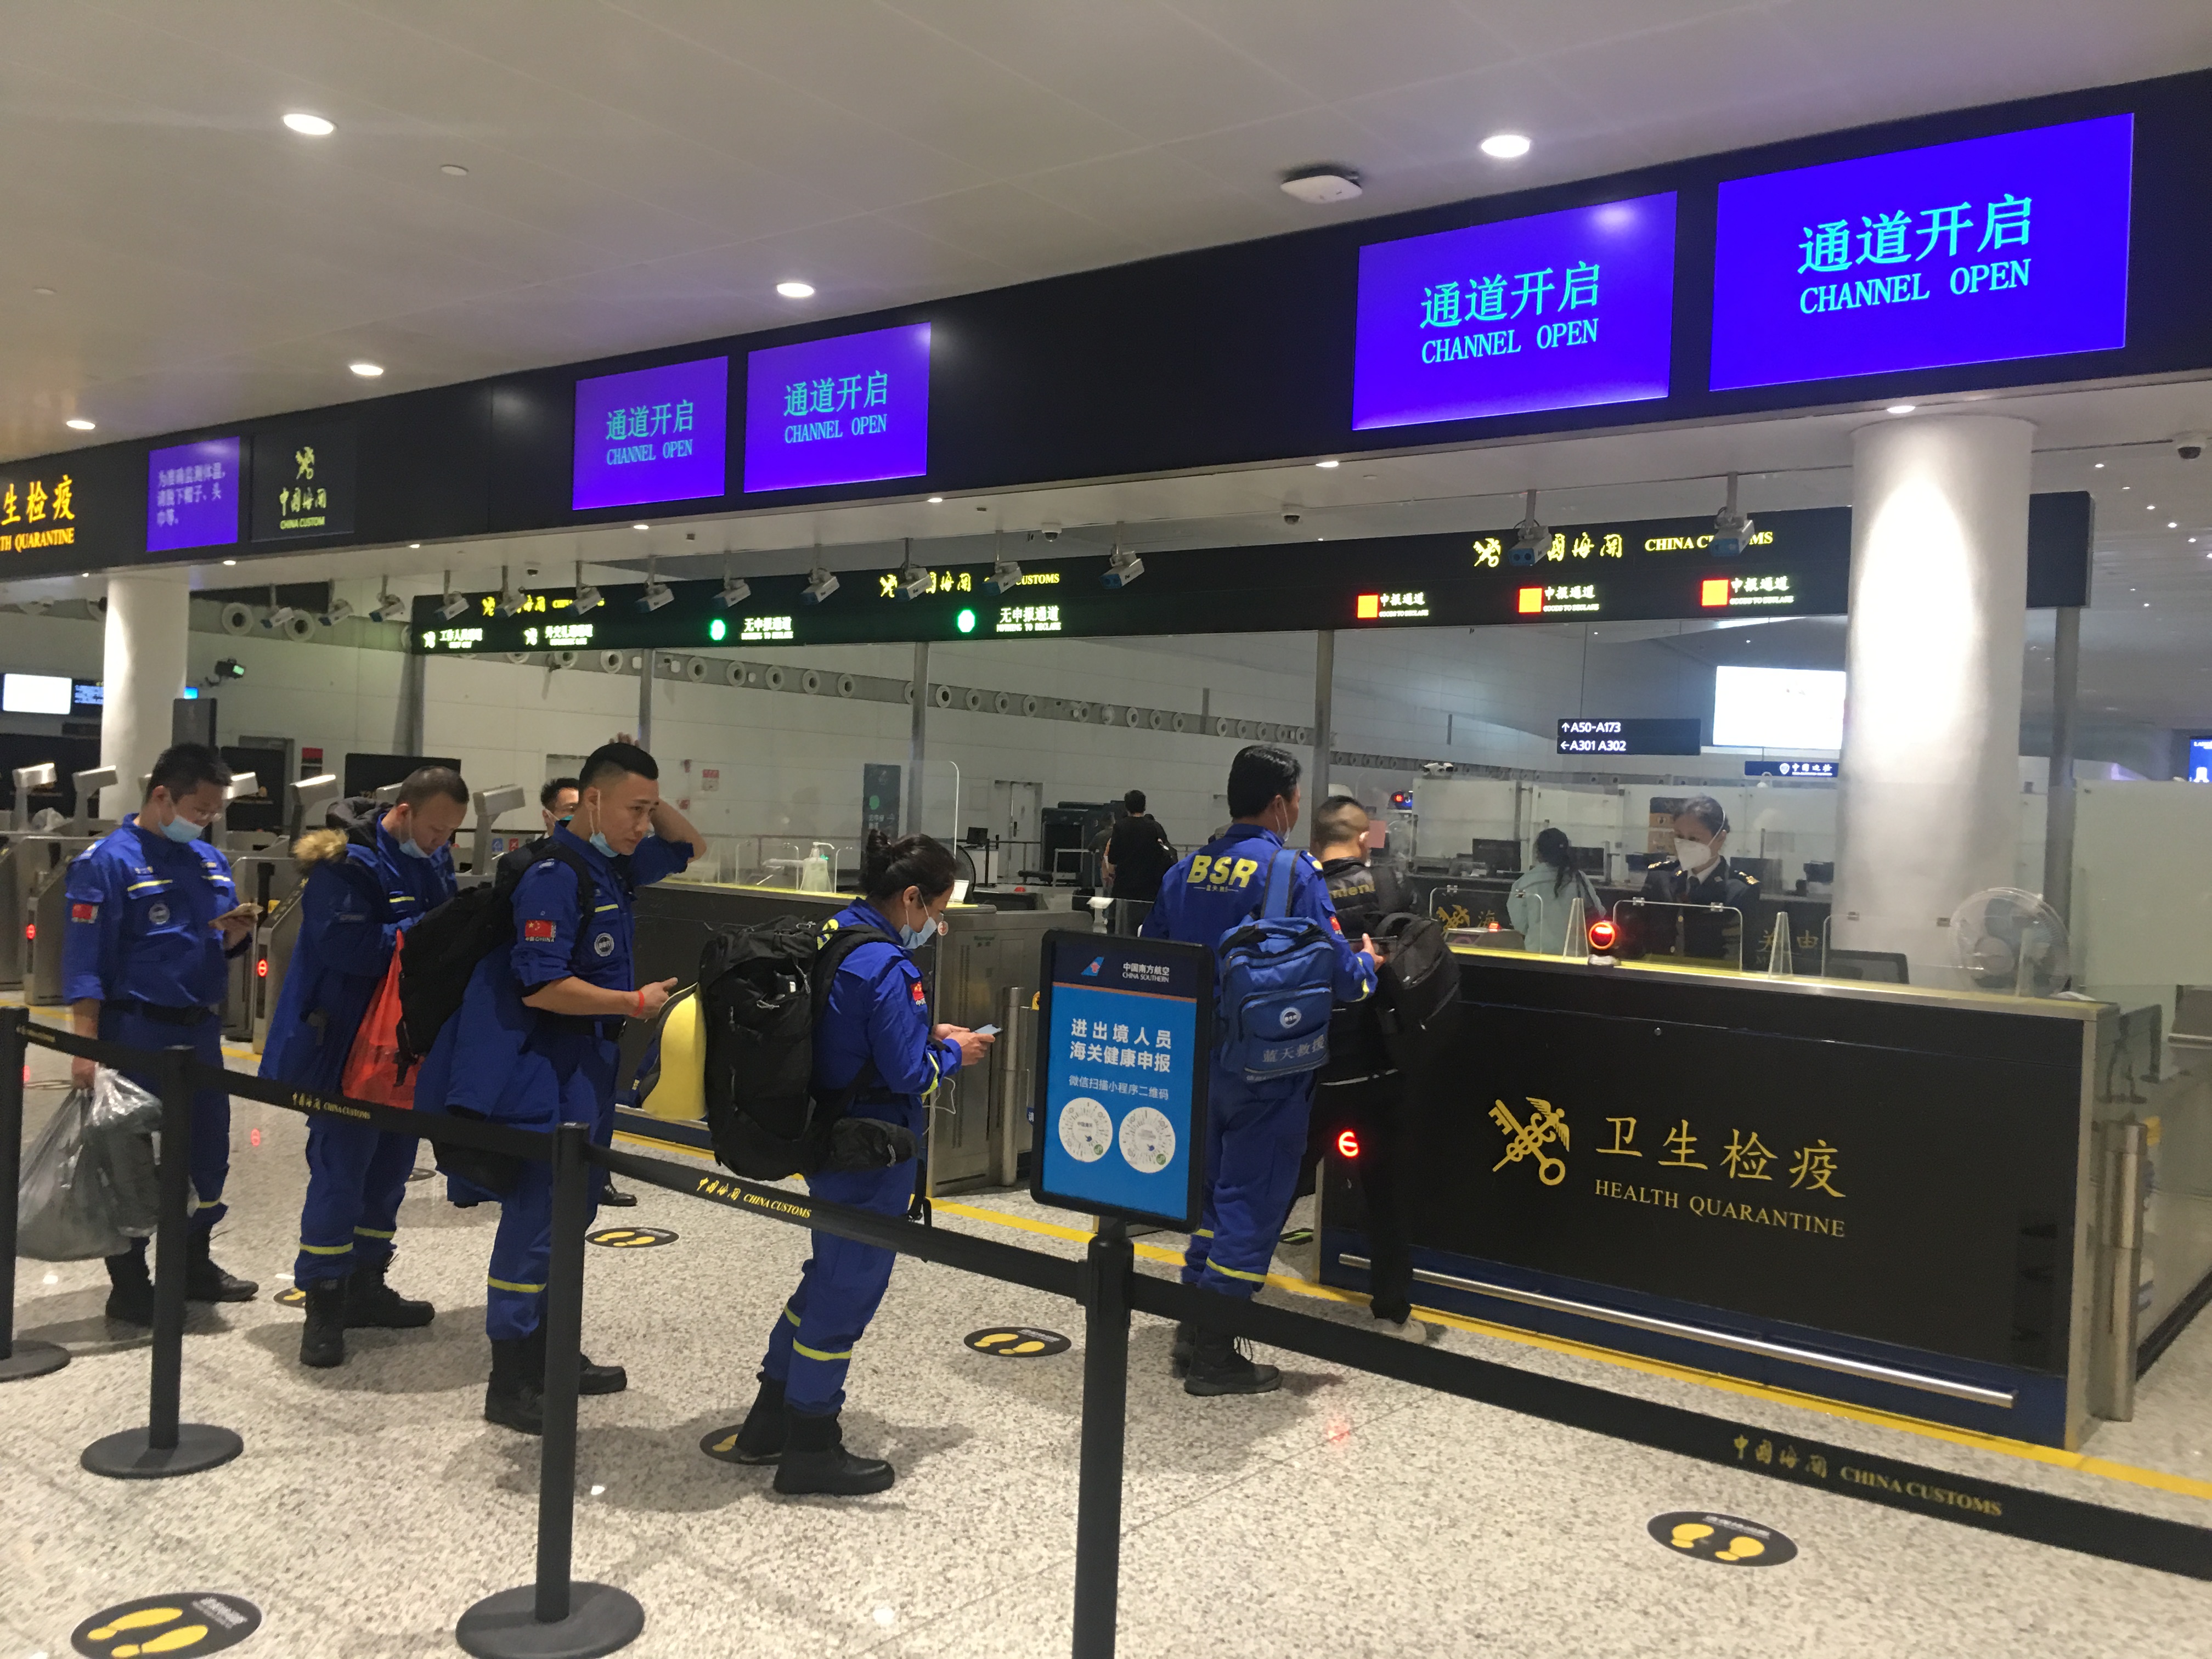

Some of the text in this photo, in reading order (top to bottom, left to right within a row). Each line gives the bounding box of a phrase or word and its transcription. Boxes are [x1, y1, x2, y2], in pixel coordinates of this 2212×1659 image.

[1798, 194, 2032, 274] 通道开启
[1420, 261, 1600, 329] 通道开启
[1800, 259, 2032, 314] CHANNEL OPEN
[1422, 318, 1599, 363] CHANNEL OPEN
[784, 370, 888, 416] 通道开启
[606, 399, 693, 440] 通道开启
[785, 414, 887, 443] CHANNEL OPEN
[607, 439, 692, 465] CHANNEL OPEN
[1, 474, 75, 525] 生检疫
[15, 527, 75, 553] QUARANTINE
[1645, 531, 1773, 551] CHINA CUMS
[1000, 605, 1059, 623] 无申报通道
[1570, 722, 1621, 733] A50-A173
[1570, 741, 1627, 752] A301 A302
[1187, 855, 1258, 888] BSR
[1123, 962, 1170, 976] 中国南方航空
[1071, 1018, 1172, 1049] 进出境人员
[1262, 1034, 1325, 1063] 蓝天救援
[1069, 1040, 1170, 1073] 海关健康申报
[1069, 1075, 1169, 1101] 微信扫描小程序二维码
[1595, 1117, 1846, 1198] 卫生检疫
[743, 1193, 811, 1218] CHINA CUSTOMS
[1595, 1180, 1845, 1237] HEALTH QUARANTINE
[1839, 1465, 2002, 1516] CHINA CUSTOMS
